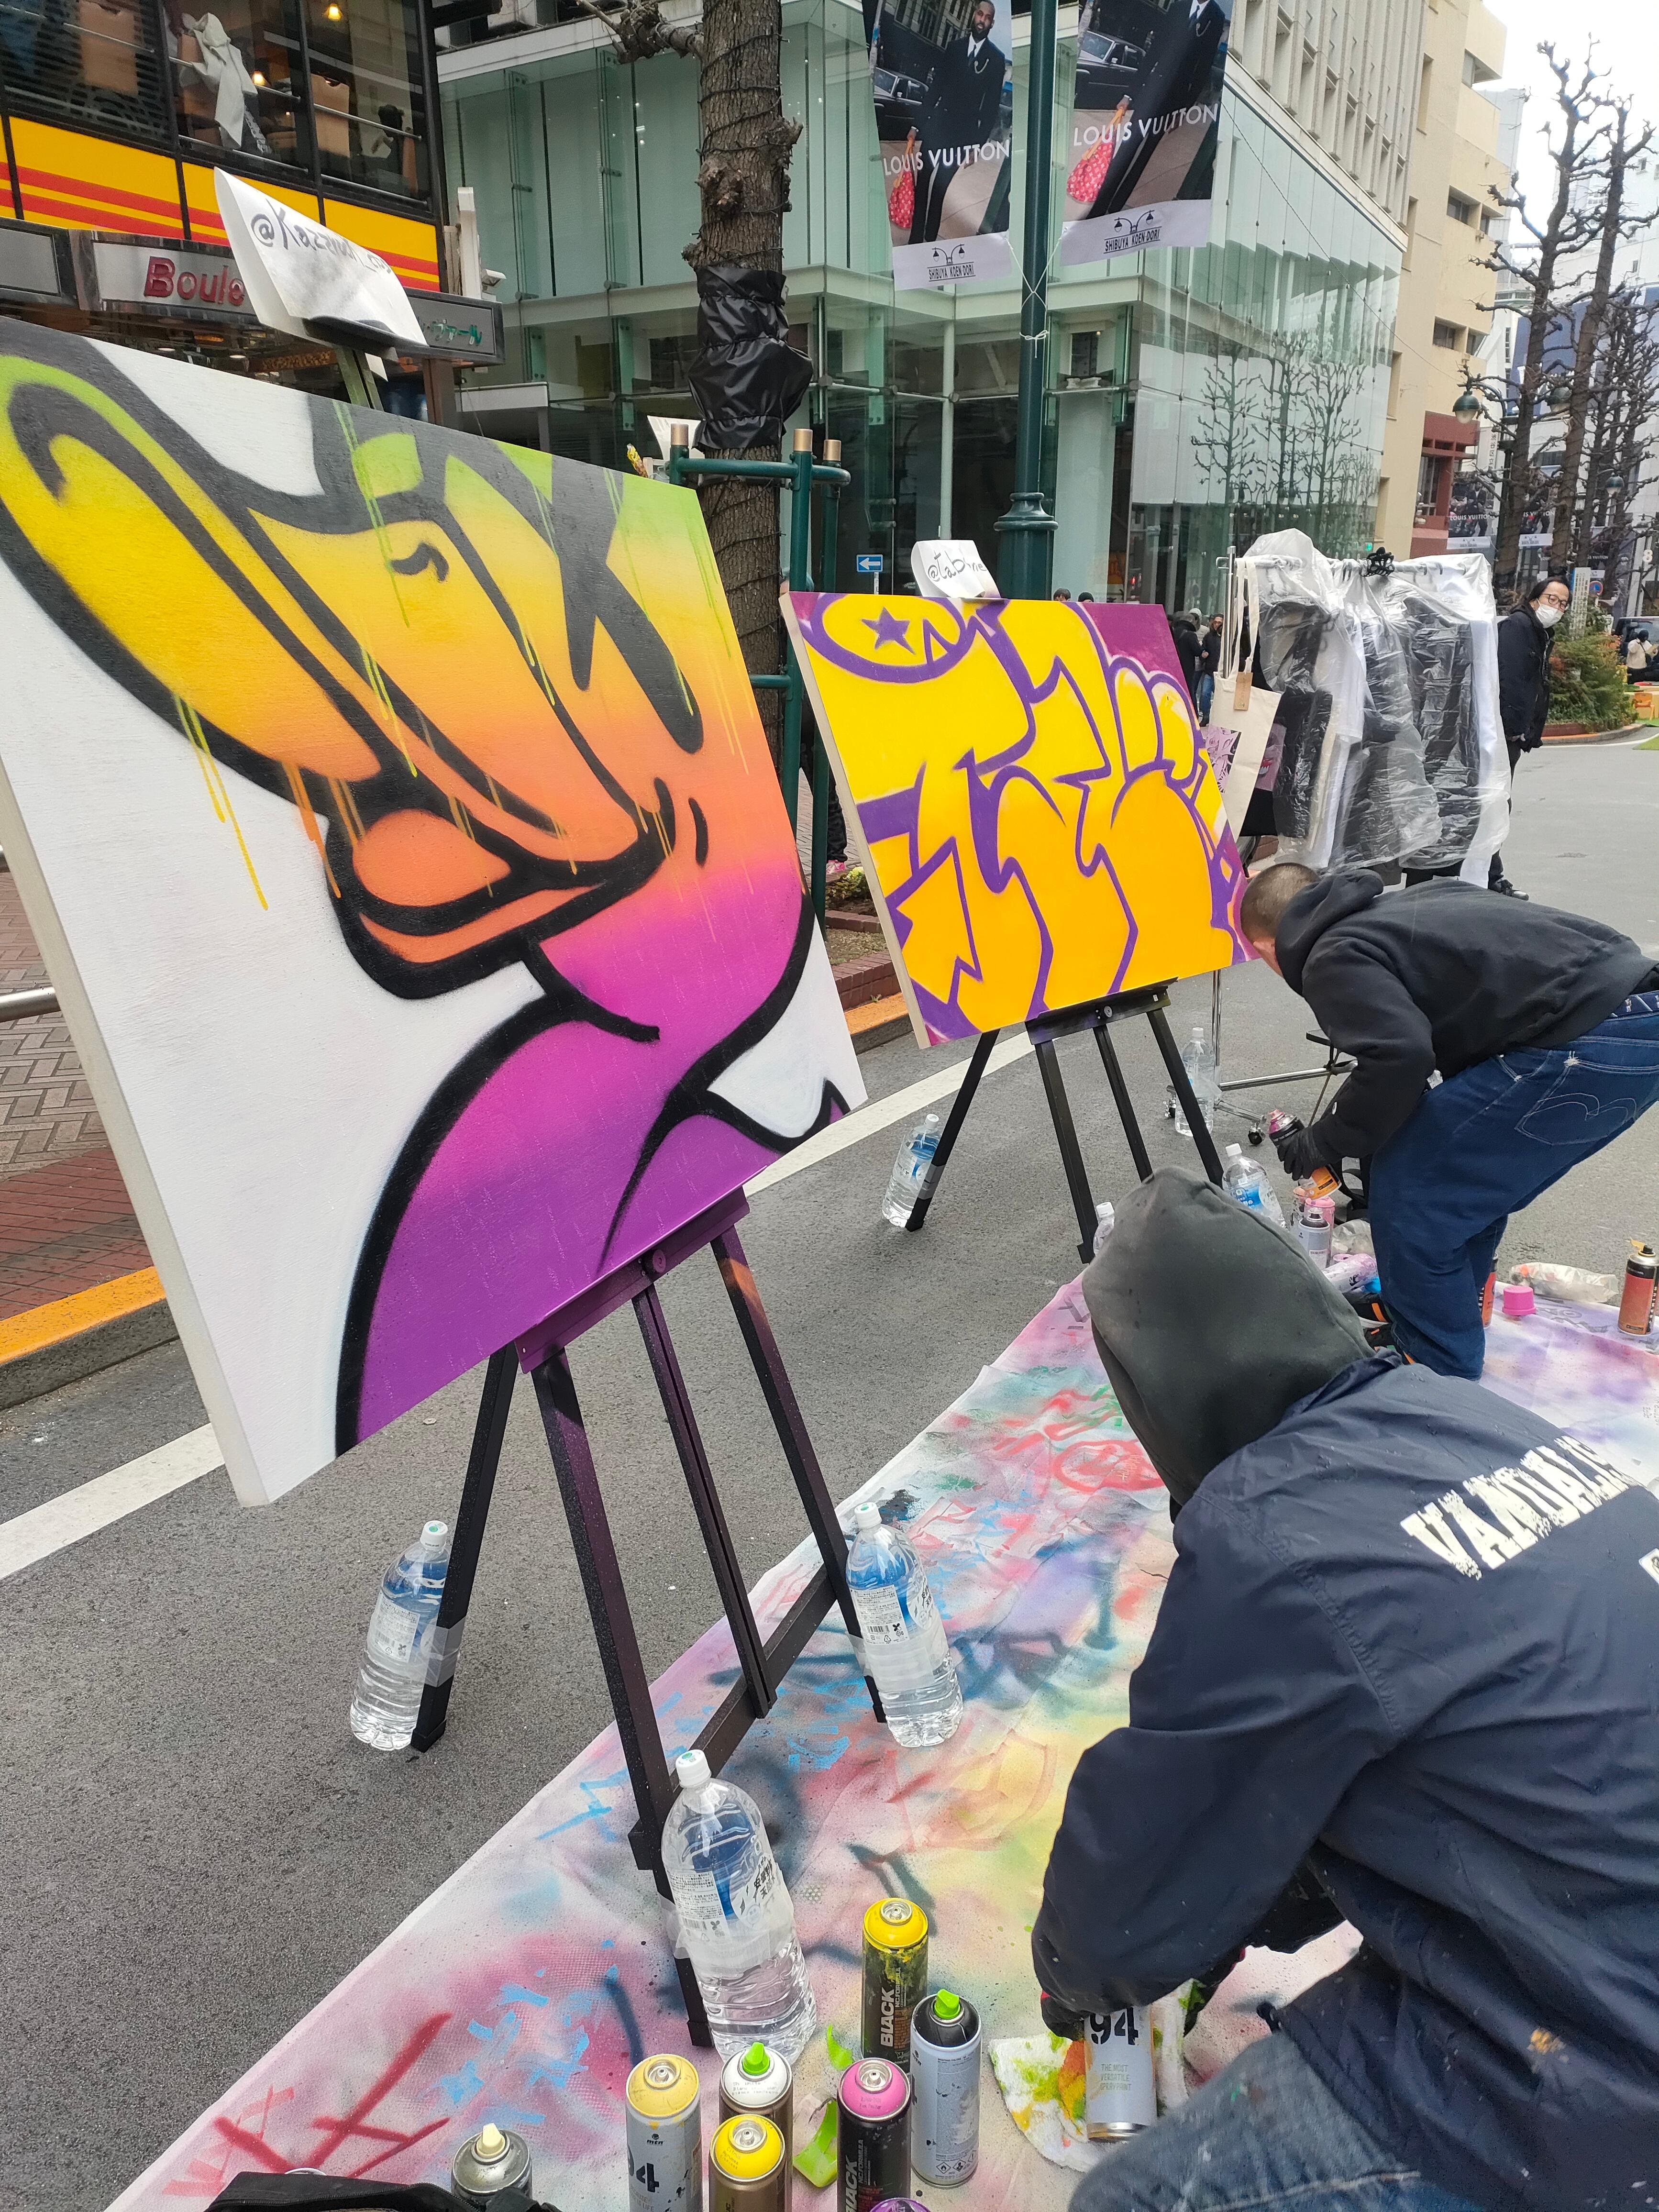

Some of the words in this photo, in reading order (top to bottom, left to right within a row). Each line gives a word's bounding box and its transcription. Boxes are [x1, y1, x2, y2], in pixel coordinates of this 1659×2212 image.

[1073, 122, 1132, 146] LOUIS
[1138, 103, 1218, 138] VUITTON
[883, 152, 924, 176] LOUIS
[928, 139, 1010, 168] VUITTON
[1105, 237, 1128, 251] SHIBUYA
[144, 256, 245, 306] Boule
[929, 267, 948, 280] SHIBUYA
[880, 1987, 895, 2047] BLACK
[1090, 2007, 1139, 2046] 94
